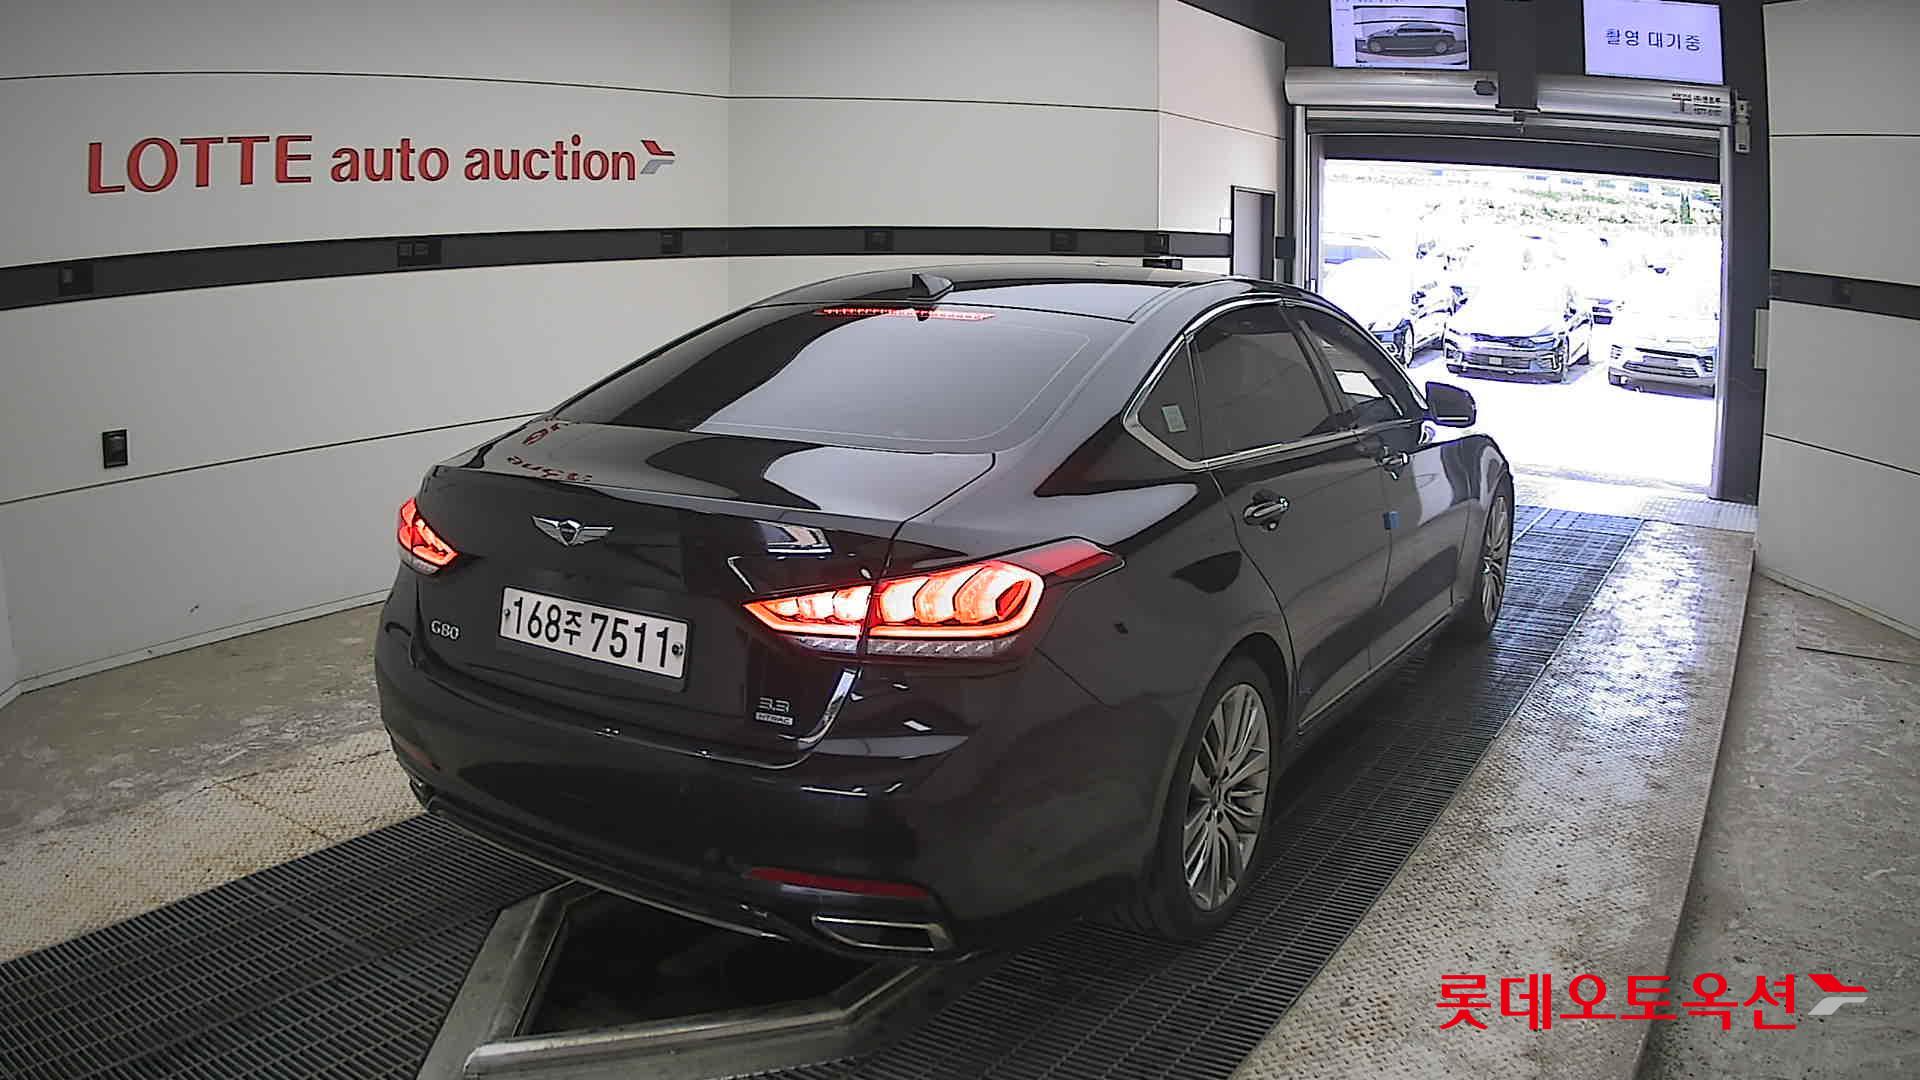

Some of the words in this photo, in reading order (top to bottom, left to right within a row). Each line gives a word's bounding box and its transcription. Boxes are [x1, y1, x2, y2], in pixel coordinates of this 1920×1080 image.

[1648, 31, 1701, 52] 대기중
[87, 135, 313, 194] LOTTE
[330, 138, 449, 183] auto
[463, 133, 636, 182] auction
[431, 620, 460, 640] G80
[512, 596, 583, 646] 168주
[590, 613, 670, 668] 7511
[758, 696, 790, 713] 3.3
